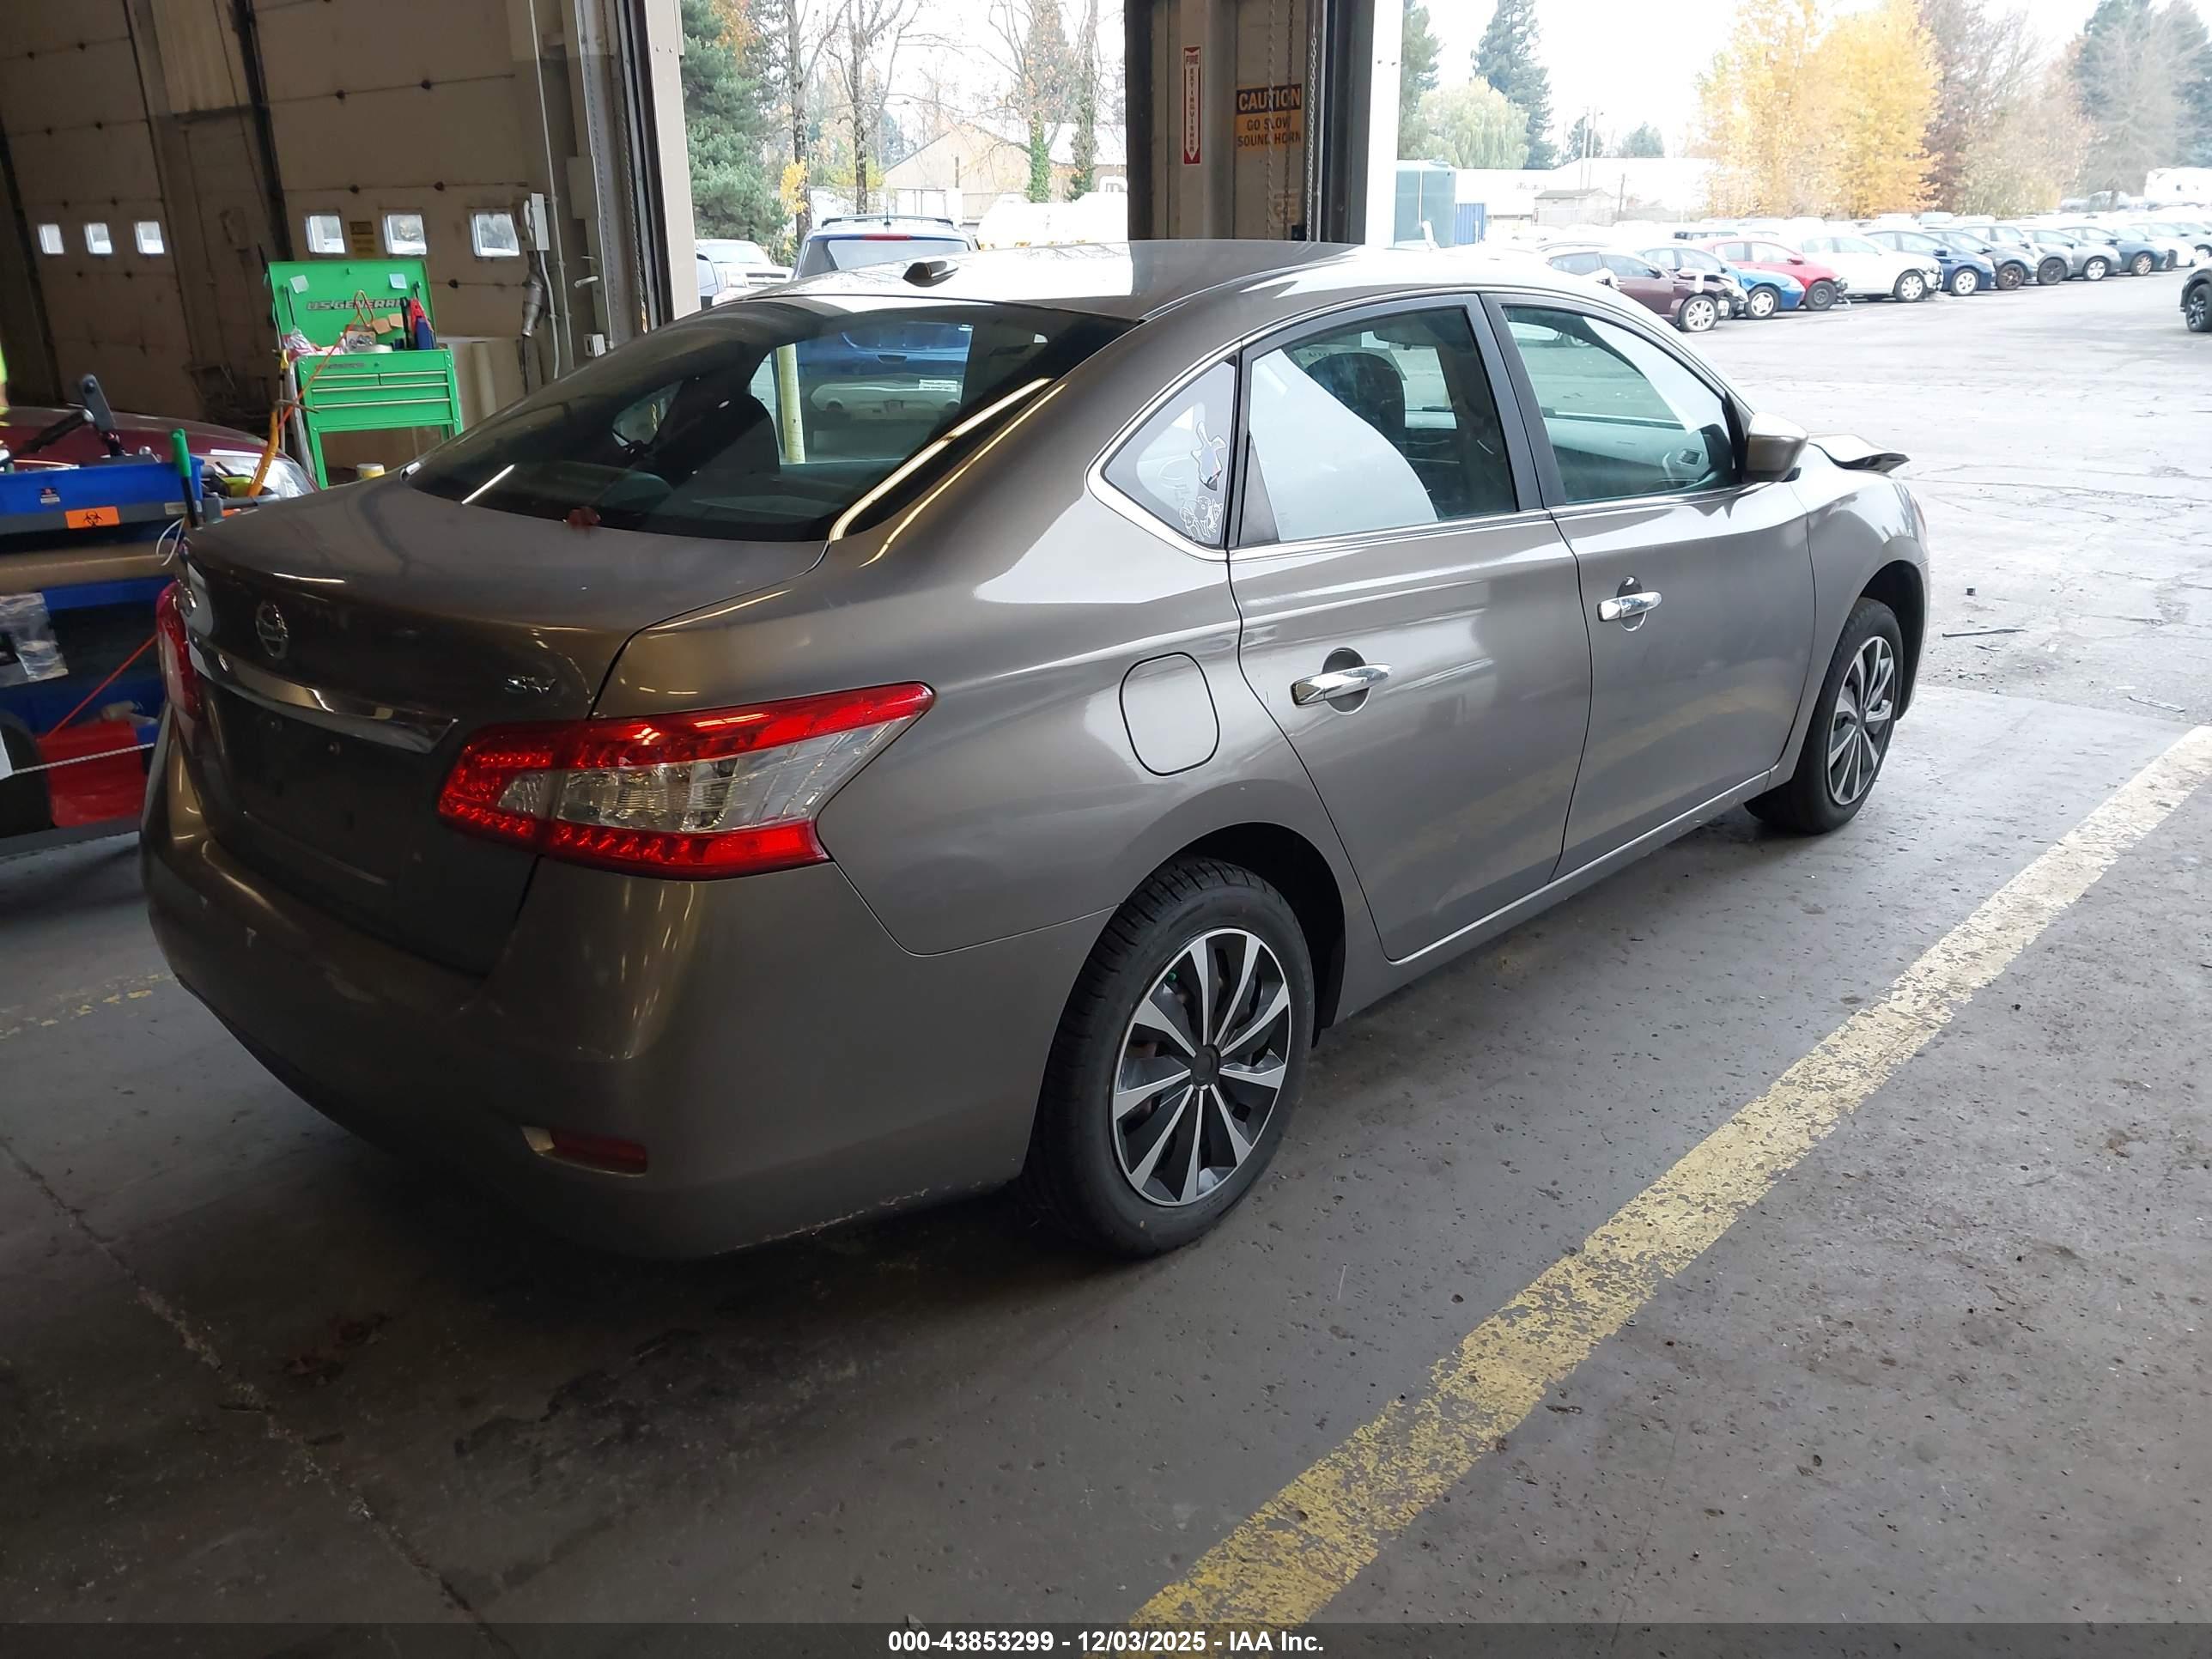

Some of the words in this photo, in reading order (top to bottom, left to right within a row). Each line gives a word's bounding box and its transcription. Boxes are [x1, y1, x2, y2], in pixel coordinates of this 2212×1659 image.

[1186, 54, 1199, 64] FIRE
[1238, 88, 1301, 111] CAUTION
[1247, 119, 1261, 131] GO
[1264, 117, 1291, 131] SLOW
[1237, 133, 1272, 147] SOUND
[1274, 131, 1301, 145] HORN
[503, 676, 556, 694] SV
